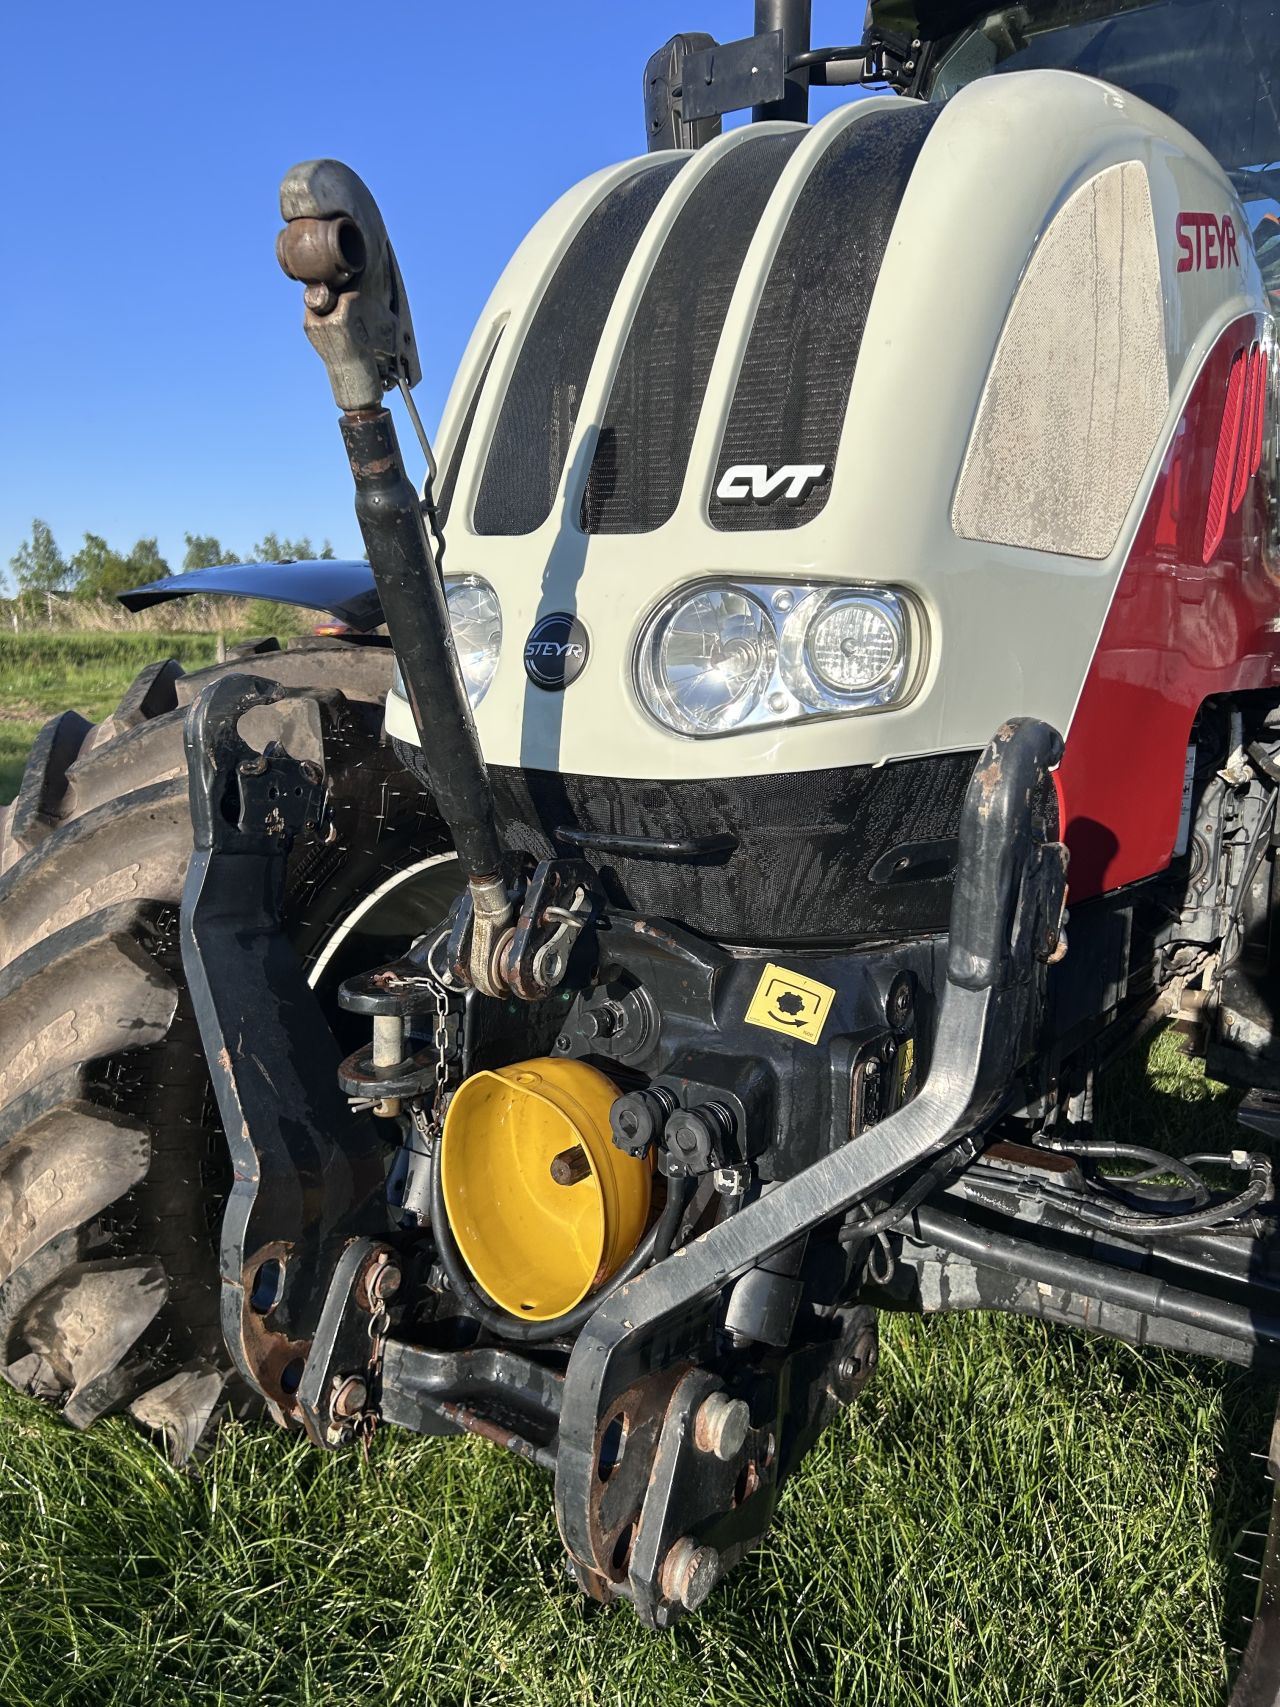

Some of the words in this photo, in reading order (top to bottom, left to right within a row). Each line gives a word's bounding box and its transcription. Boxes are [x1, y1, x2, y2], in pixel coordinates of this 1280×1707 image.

[1176, 212, 1239, 273] STEYR
[716, 464, 826, 499] CVT
[525, 641, 583, 658] STEYR
